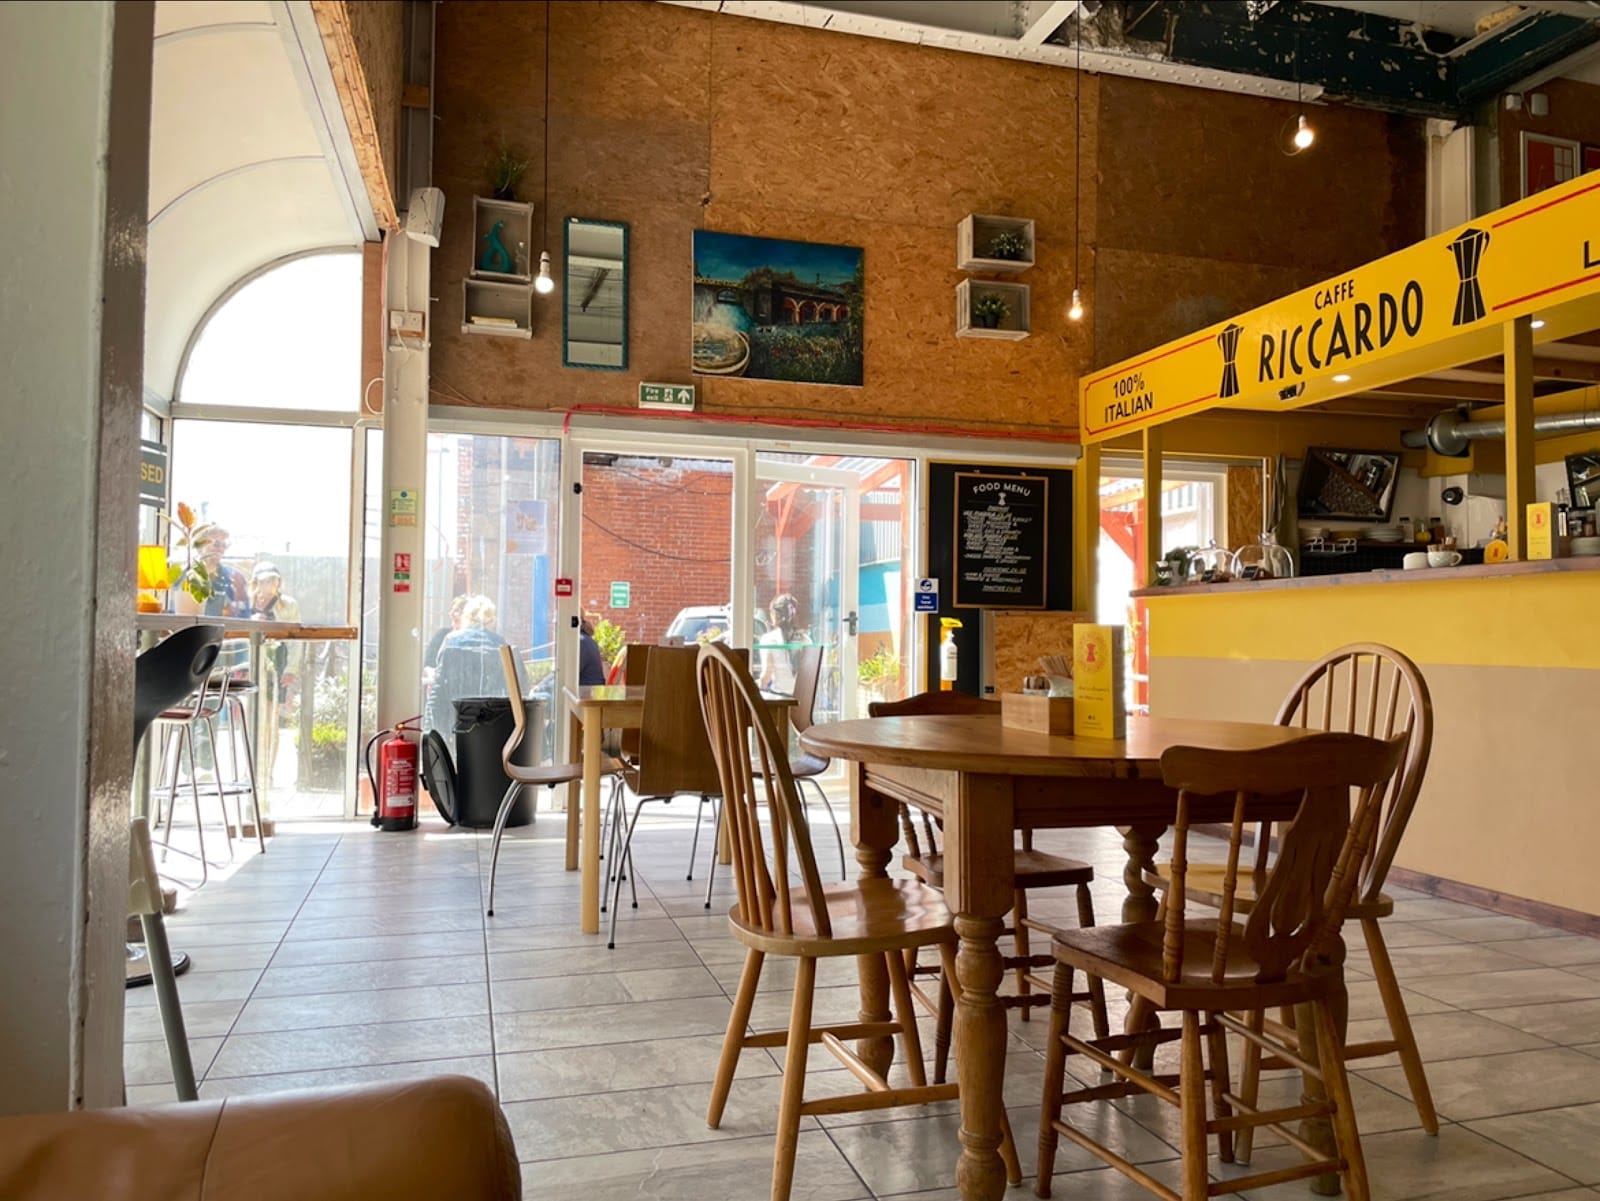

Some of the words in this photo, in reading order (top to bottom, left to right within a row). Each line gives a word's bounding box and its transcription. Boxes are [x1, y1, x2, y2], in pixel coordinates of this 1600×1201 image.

[1315, 279, 1355, 310] CAFFE
[1259, 280, 1423, 383] RICCARDO
[1113, 372, 1145, 398] 100%
[1105, 392, 1153, 423] ITALIAN
[972, 482, 1001, 495] FOOD
[1003, 482, 1031, 496] MENU
